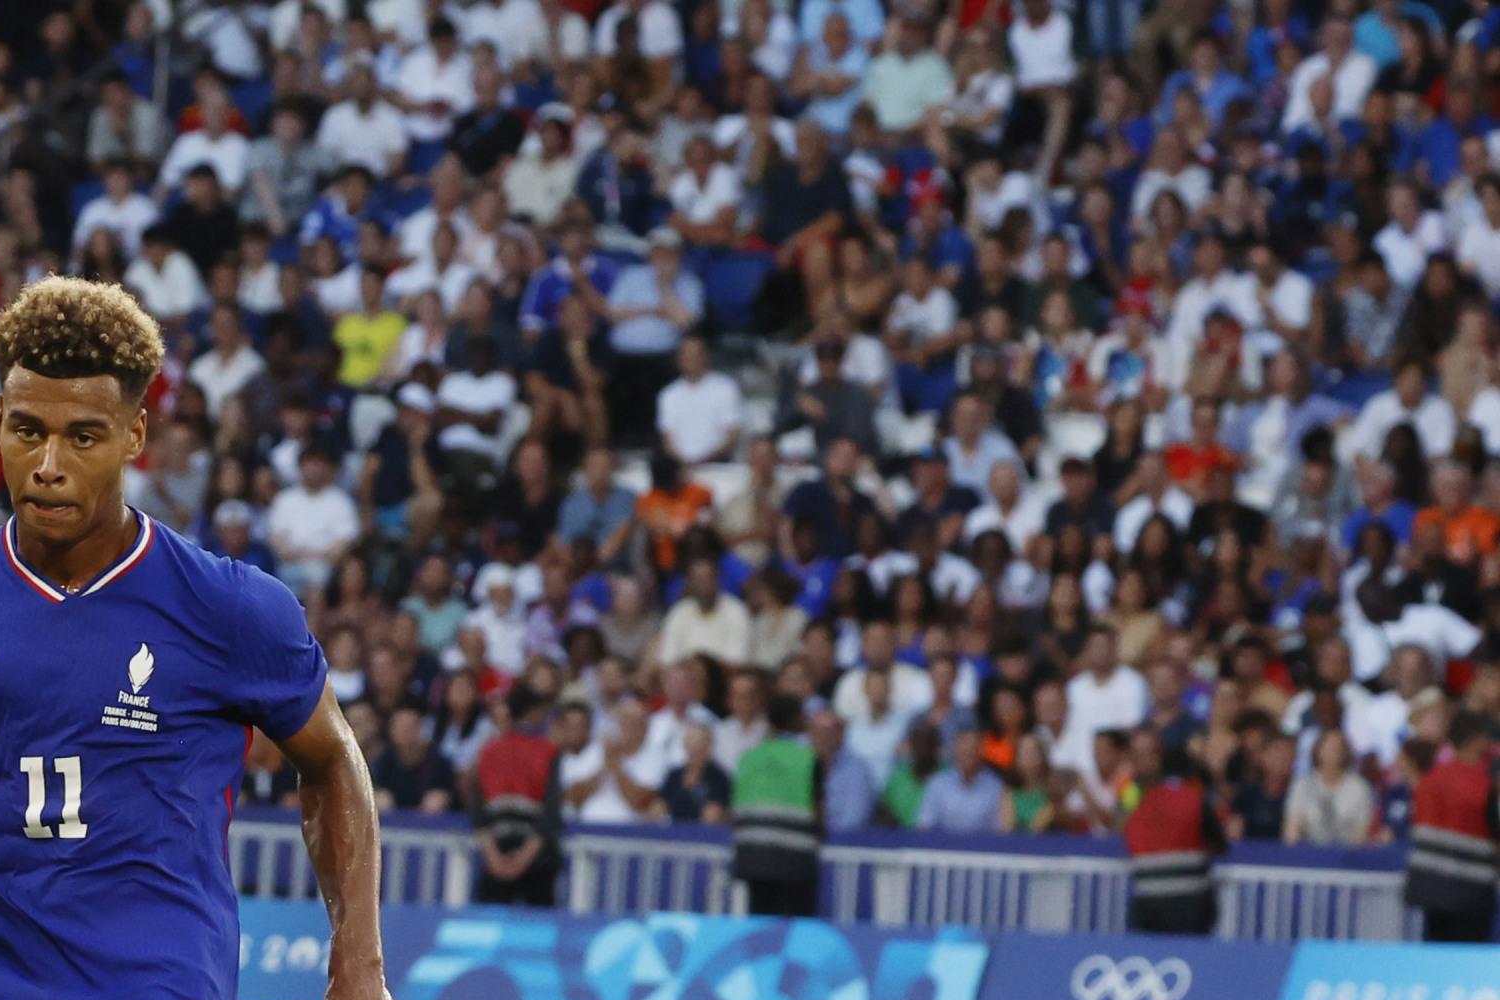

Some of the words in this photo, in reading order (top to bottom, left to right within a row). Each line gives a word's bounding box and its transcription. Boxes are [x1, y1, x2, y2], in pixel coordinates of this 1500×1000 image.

[118, 690, 150, 708] FRANCE
[104, 706, 127, 717] FRANCE
[20, 756, 88, 839] 11
